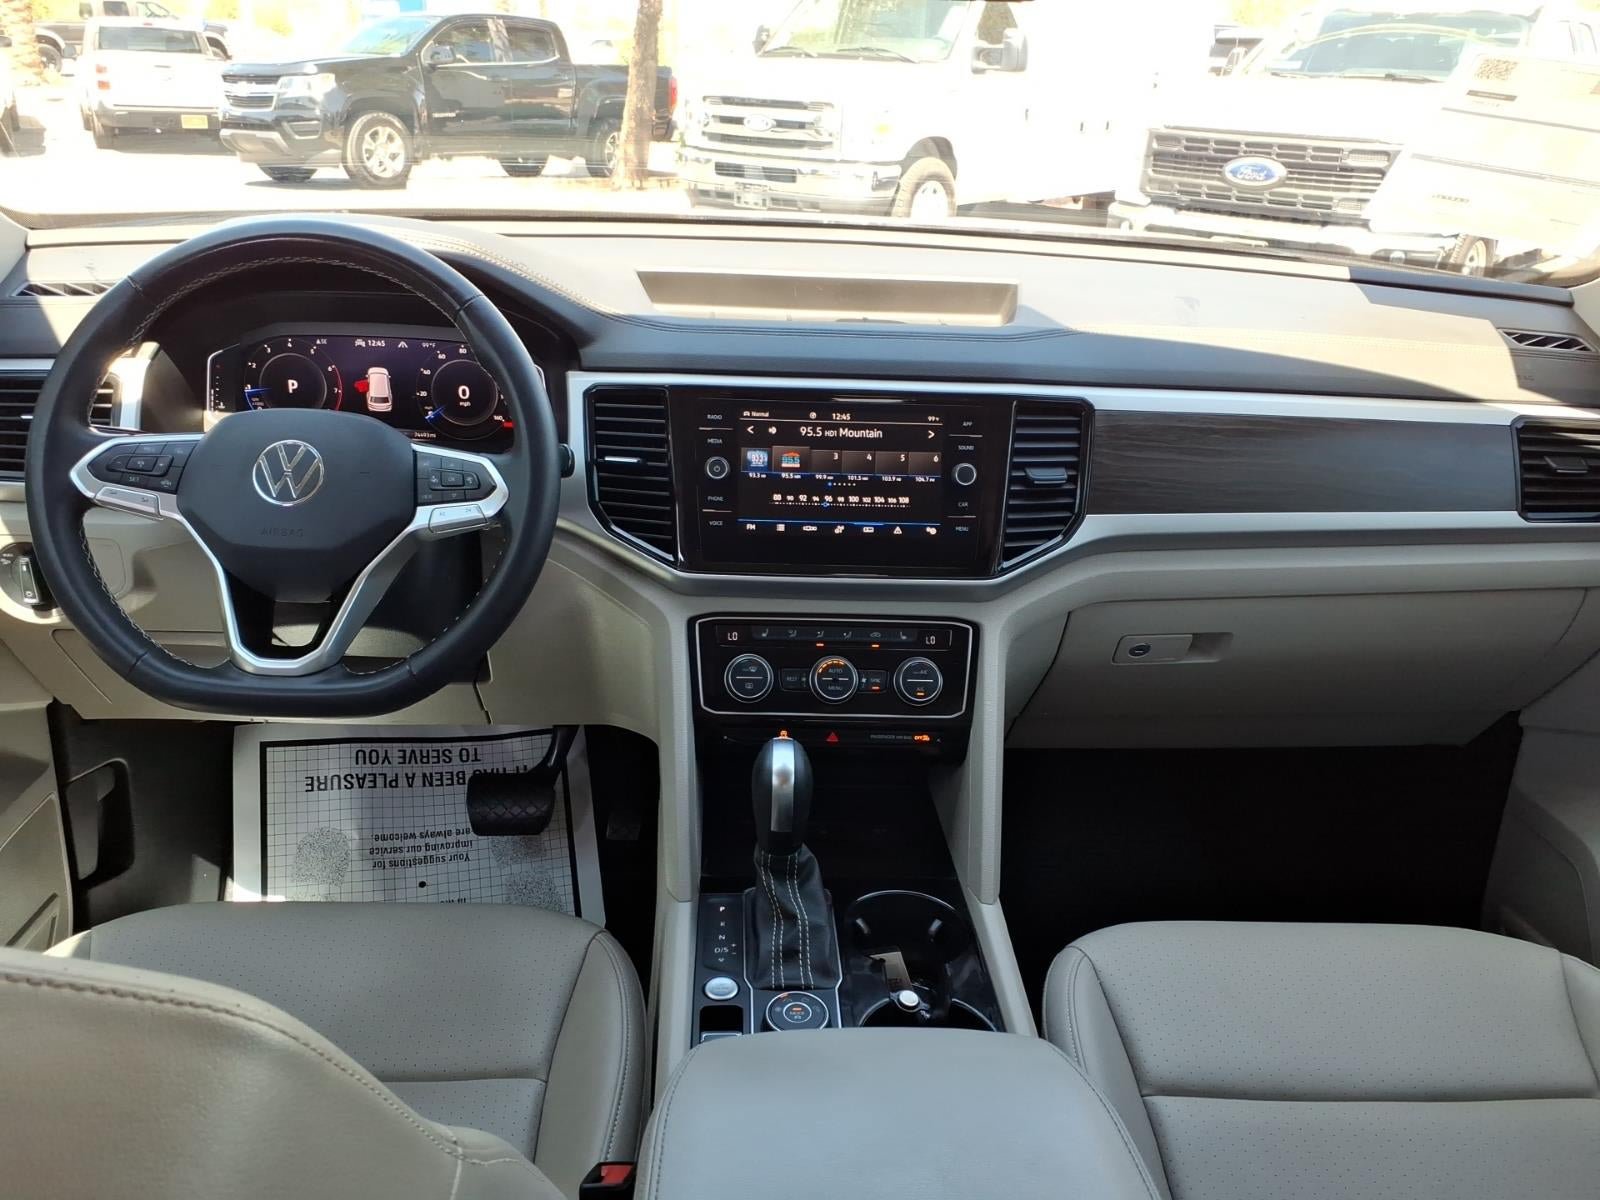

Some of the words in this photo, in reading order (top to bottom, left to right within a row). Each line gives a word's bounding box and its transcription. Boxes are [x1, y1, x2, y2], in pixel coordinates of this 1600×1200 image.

[287, 379, 299, 394] P
[458, 385, 470, 400] 0
[751, 410, 770, 418] Normal
[832, 413, 851, 421] 12:45
[800, 426, 823, 437] 95.5
[839, 427, 883, 439] Mountain
[866, 453, 873, 461] 4
[900, 454, 906, 462] 5
[933, 455, 940, 463] 6
[799, 494, 807, 502] 92
[355, 749, 392, 765] YOU
[397, 748, 453, 765] SERVE
[459, 747, 482, 763] TO
[304, 772, 399, 792] PLEASURE
[405, 772, 416, 788] A
[422, 770, 467, 788] BEEN
[419, 829, 453, 839] always
[455, 827, 471, 836] are
[406, 845, 422, 854] our
[424, 839, 473, 852] improving
[369, 847, 404, 856] service
[388, 854, 446, 868] suggestions
[448, 852, 471, 863] Your
[372, 860, 386, 869] for
